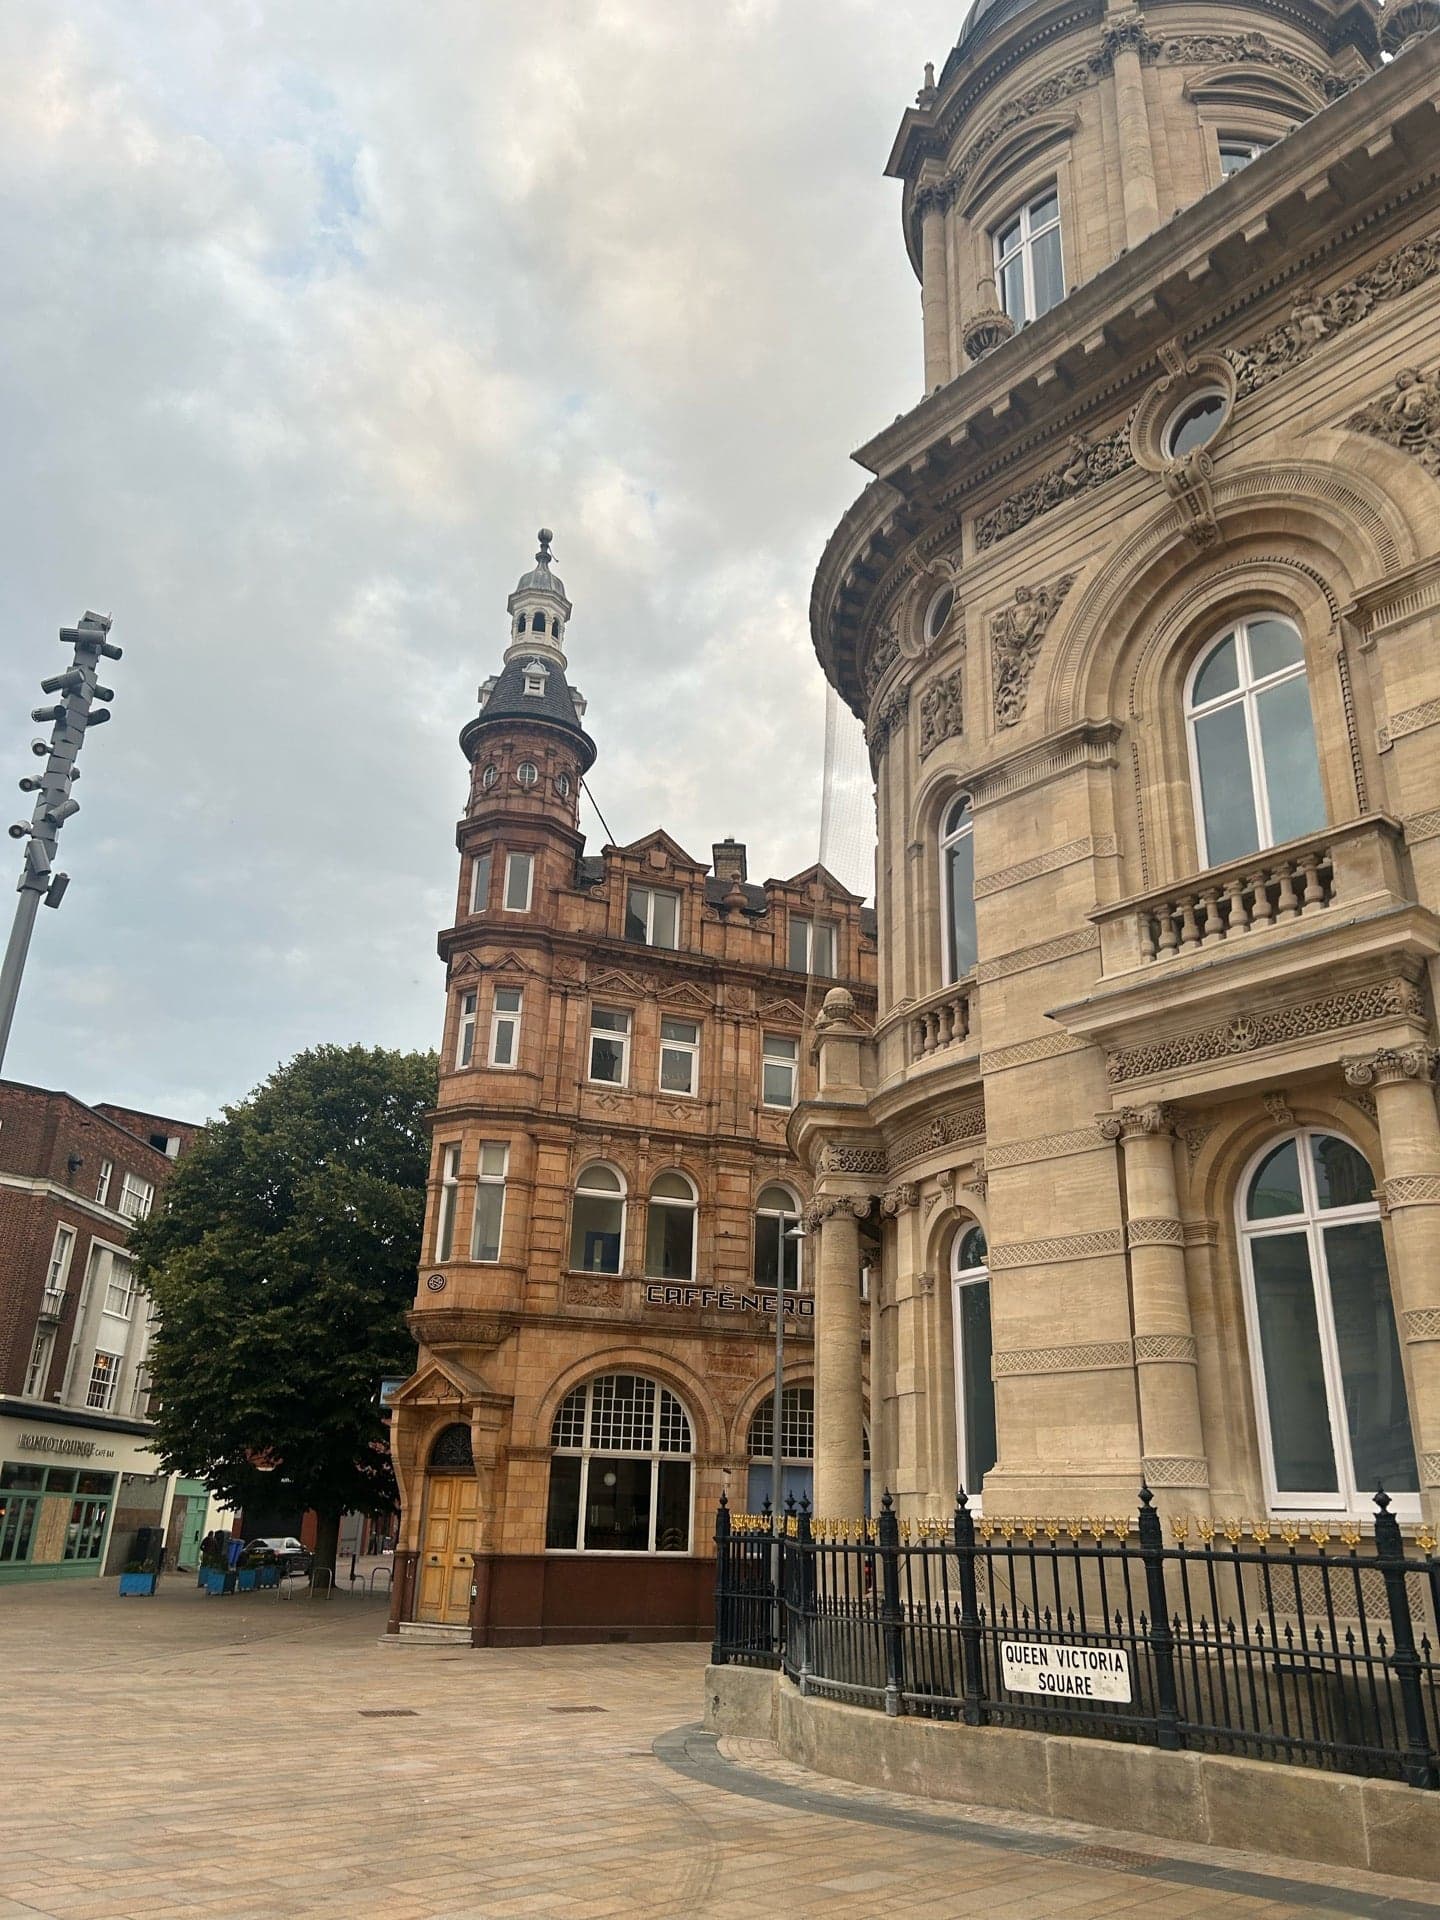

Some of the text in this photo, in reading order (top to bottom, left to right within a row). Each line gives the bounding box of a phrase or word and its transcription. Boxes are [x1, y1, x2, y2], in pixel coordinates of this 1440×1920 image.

[646, 1284, 815, 1316] CAFFÈ NERO
[1006, 1645, 1124, 1672] QUEEN VICTORIA
[1038, 1672, 1093, 1695] SQUARE
